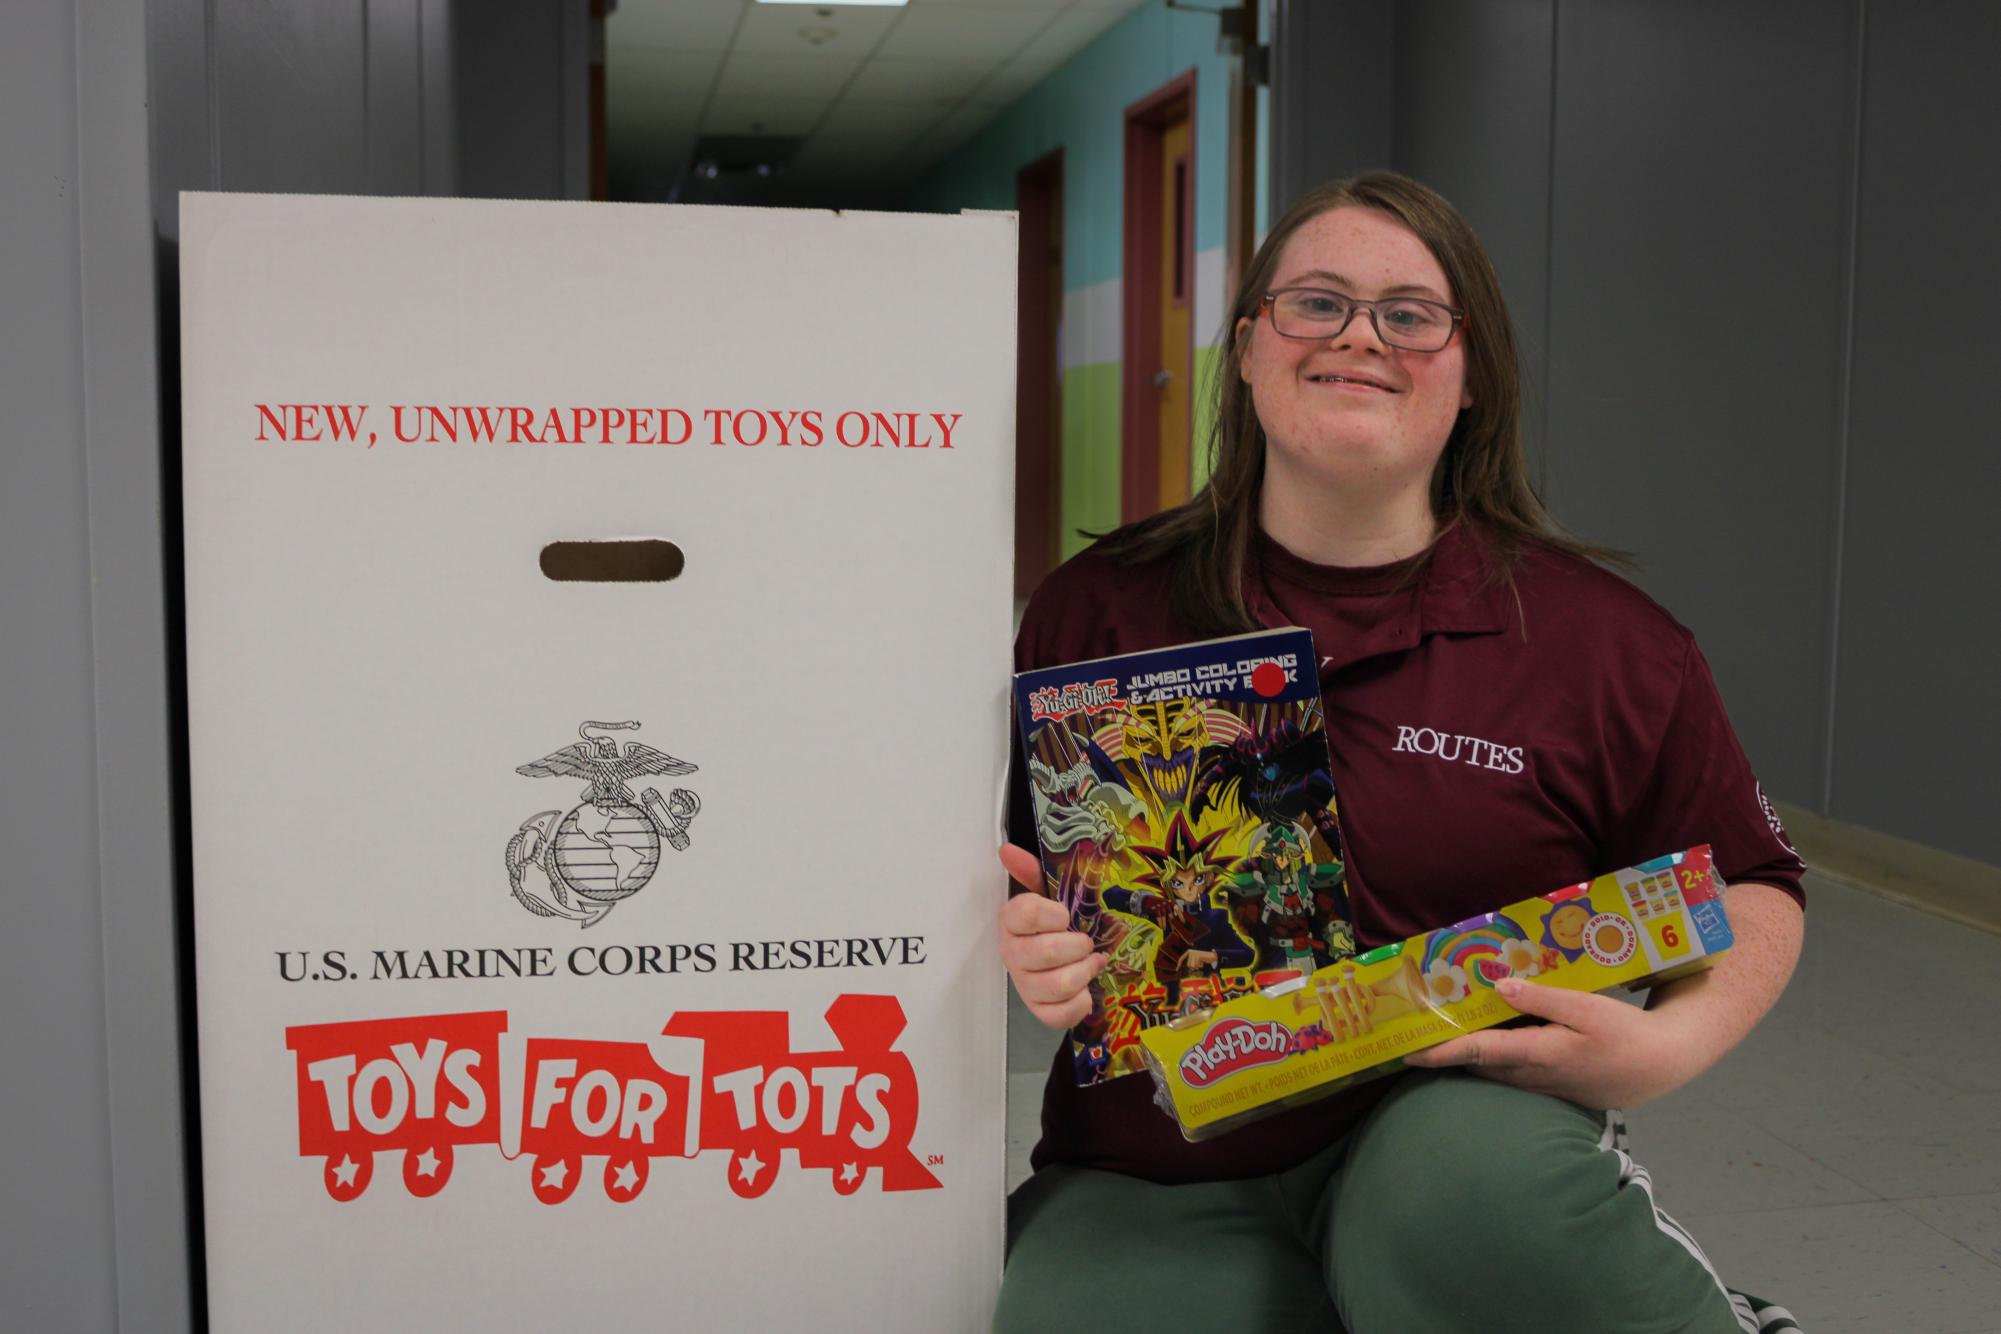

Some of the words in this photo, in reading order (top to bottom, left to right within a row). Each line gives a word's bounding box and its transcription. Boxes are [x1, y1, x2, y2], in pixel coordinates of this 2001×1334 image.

[256, 403, 378, 448] NEW,
[391, 405, 693, 446] UNWRAPPED
[703, 408, 825, 448] TOYS
[835, 410, 961, 449] ONLY
[1127, 669, 1190, 690] JUMBO
[1130, 690, 1142, 705] &
[1145, 677, 1237, 702] ACTIVITY
[1243, 669, 1298, 689] BK
[1392, 726, 1525, 774] ROUTES
[1680, 869, 1705, 889] 2+
[277, 950, 358, 982] U.S.
[372, 948, 555, 980] MARINE
[567, 943, 717, 976] CORPS
[731, 936, 926, 971] RESERVE
[1661, 924, 1679, 948] 6
[1180, 1021, 1287, 1081] Play-Doh
[307, 1038, 487, 1135] TOYS
[530, 1058, 668, 1145] FOR
[713, 1065, 892, 1150] TOTS
